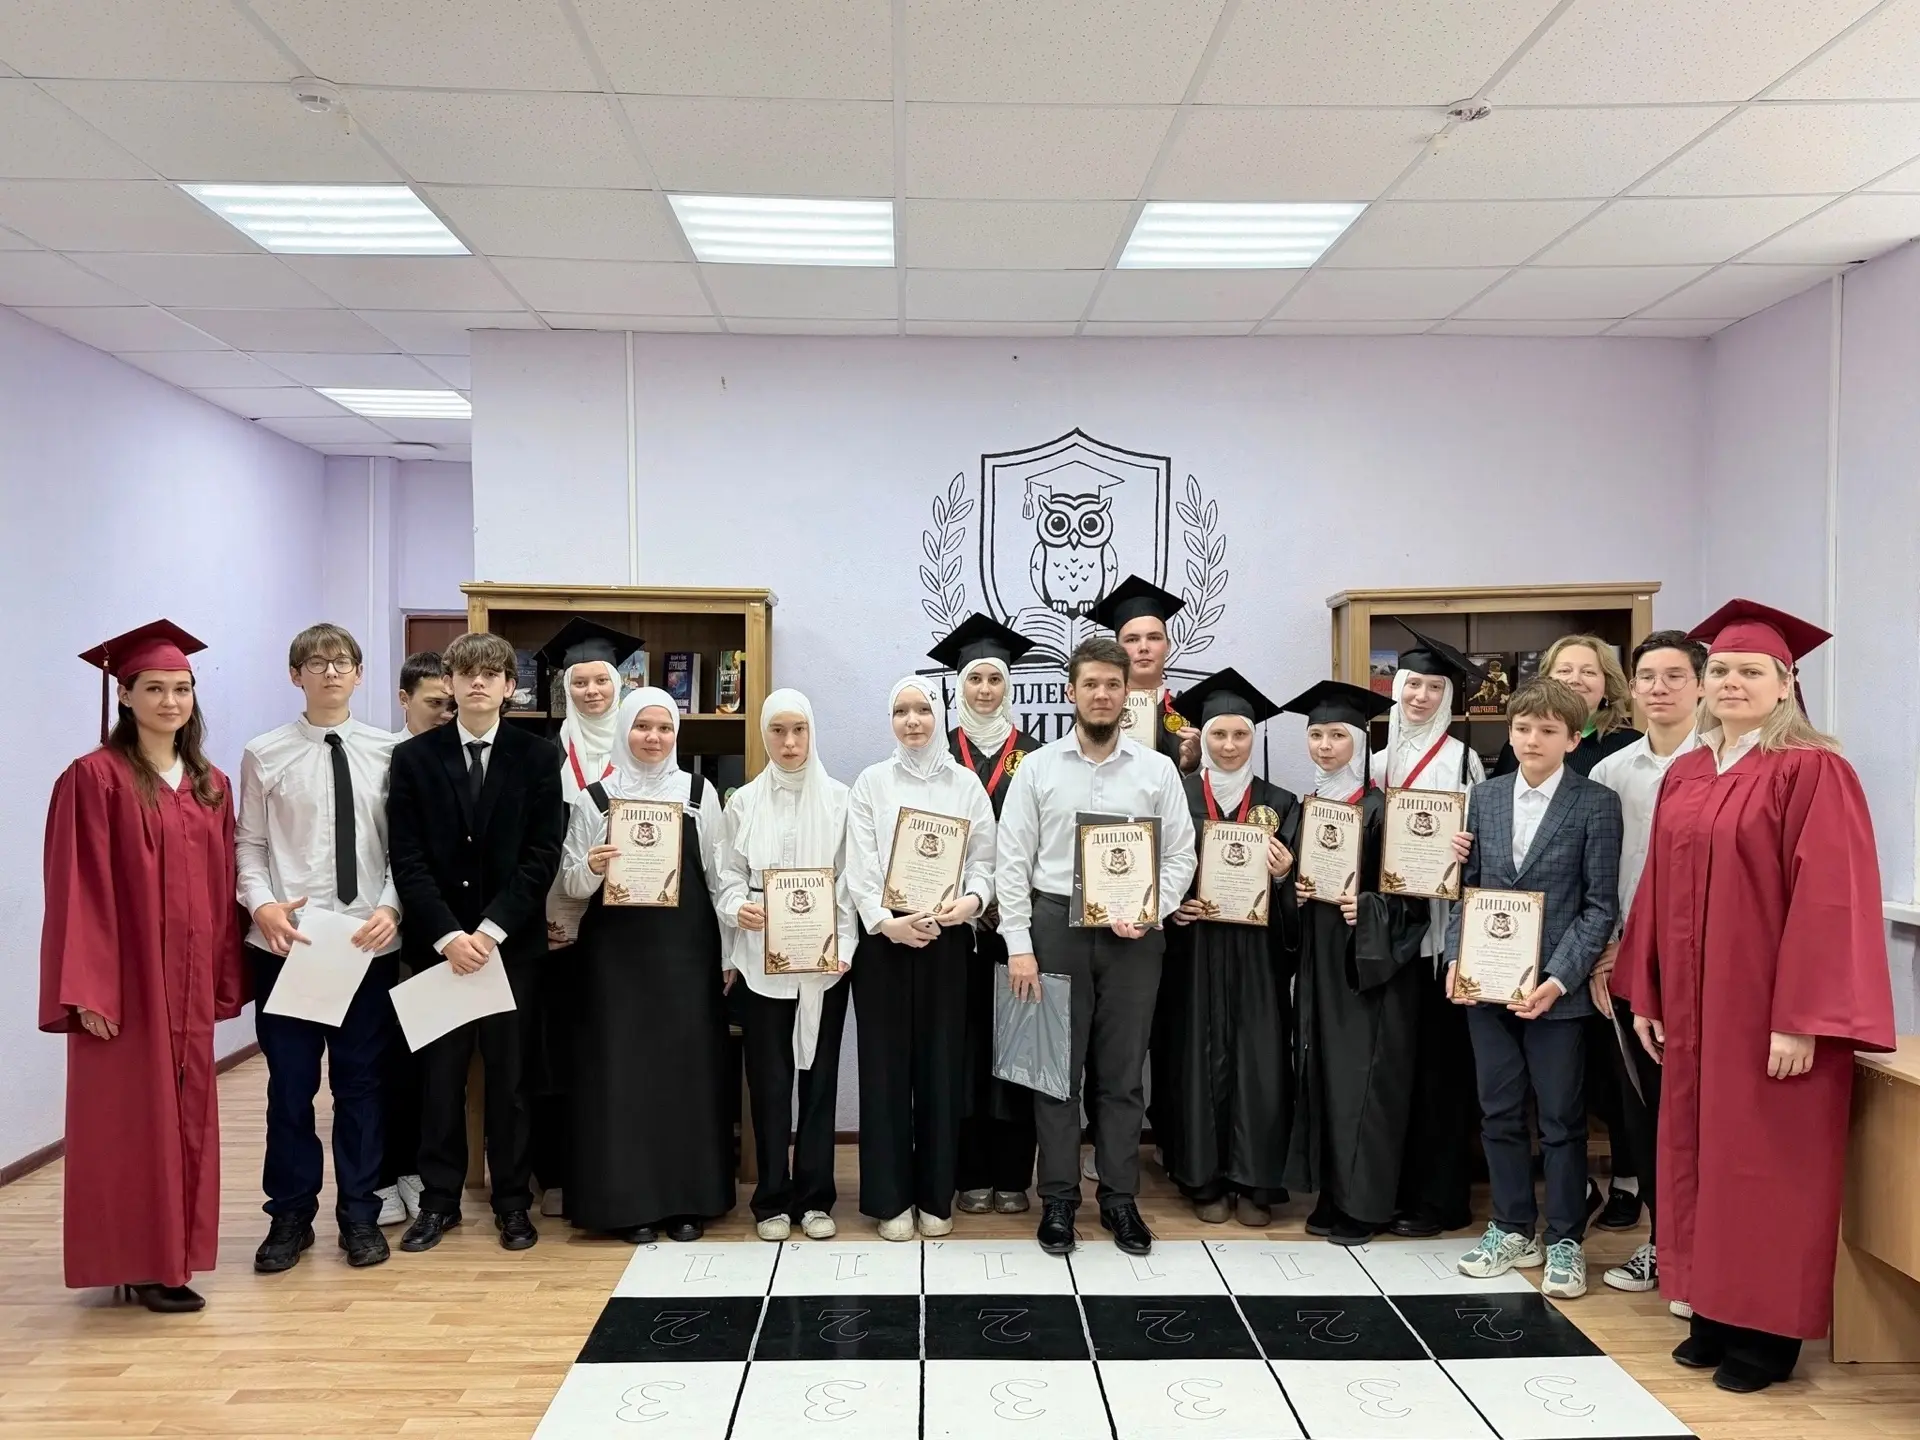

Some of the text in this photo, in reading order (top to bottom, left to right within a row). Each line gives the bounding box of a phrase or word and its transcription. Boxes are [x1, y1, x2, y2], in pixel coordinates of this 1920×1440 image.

[621, 809, 672, 822] ДИПЛОМ
[1311, 805, 1355, 823] ДИПЛОМ
[1397, 797, 1453, 812] ДИПЛОМ
[908, 818, 958, 837] ДИПЛОМ
[1092, 831, 1143, 844] ДИПЛОМ
[1213, 829, 1263, 843] ДИПЛОМ
[776, 877, 825, 890] ДИПЛОМ
[1475, 898, 1531, 913] ДИПЛОМ
[649, 1310, 710, 1345] 2
[817, 1308, 871, 1344] 2
[977, 1308, 1032, 1344] 2
[1135, 1309, 1195, 1344] 2
[1296, 1310, 1359, 1344] 2
[1455, 1308, 1524, 1342] 2
[615, 1380, 686, 1423] 3
[804, 1379, 867, 1422] 3
[990, 1378, 1048, 1421] 3
[1166, 1377, 1228, 1420] 3
[1346, 1377, 1412, 1419] 3
[1524, 1375, 1596, 1418] 3
